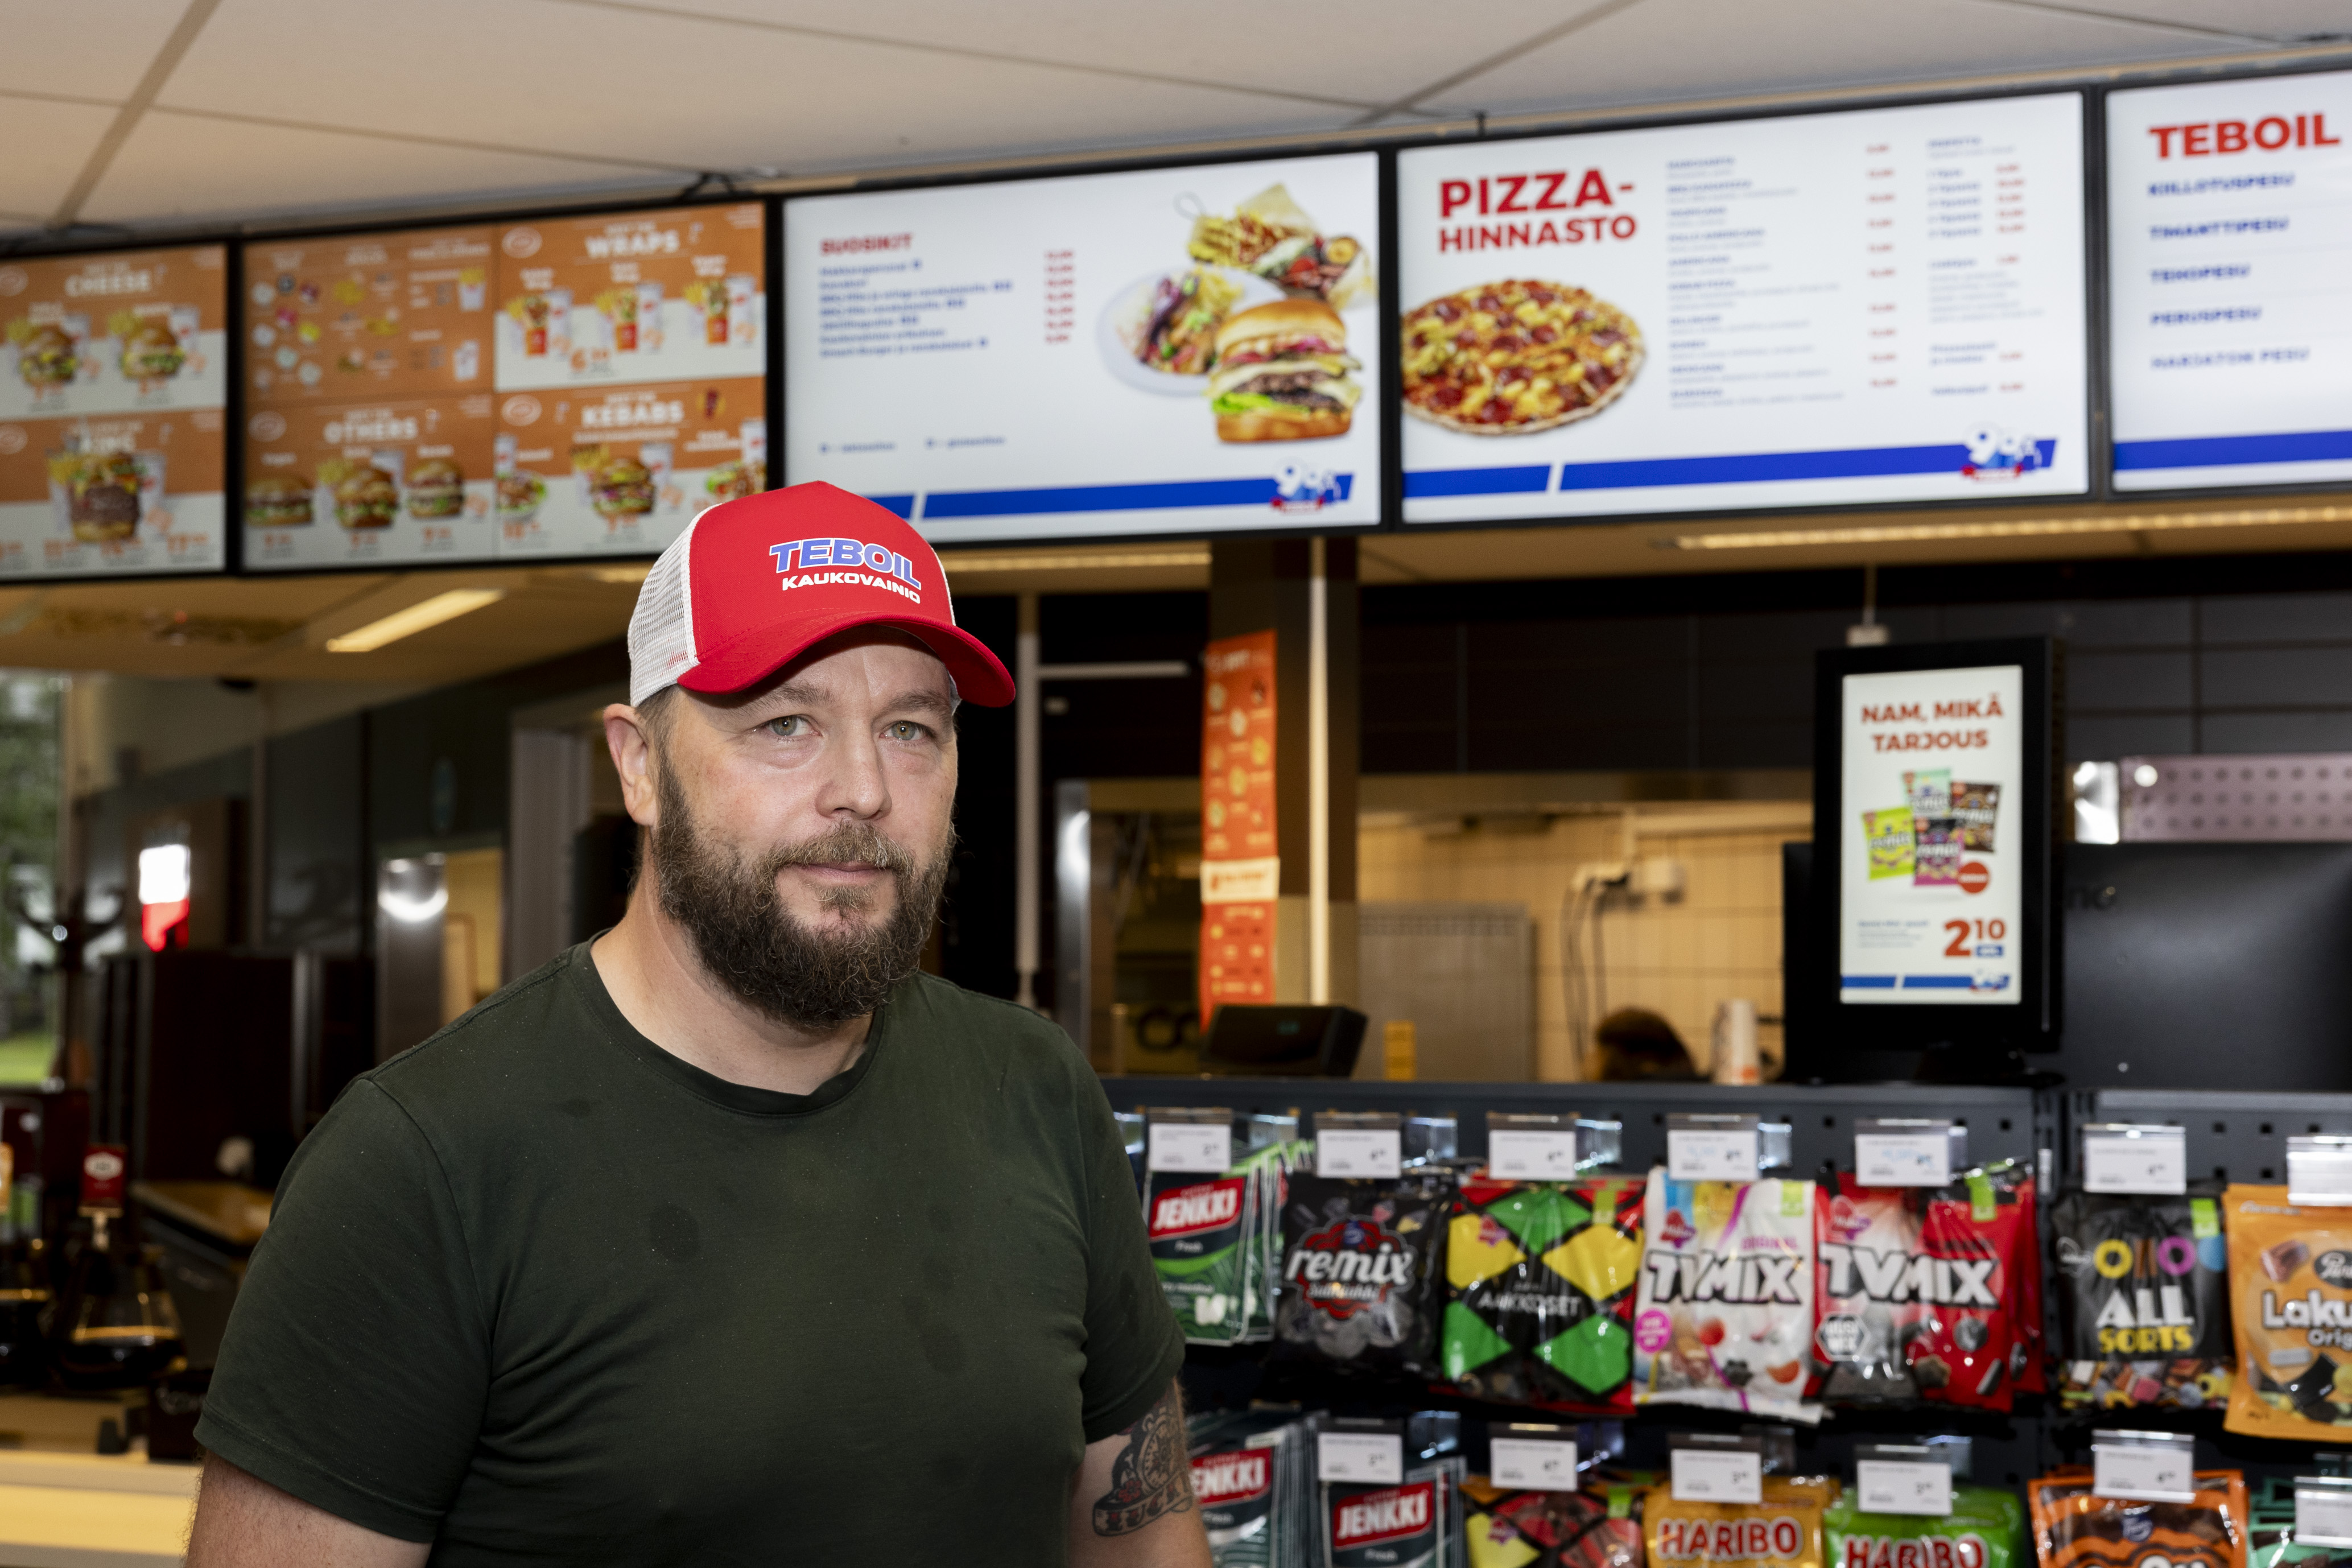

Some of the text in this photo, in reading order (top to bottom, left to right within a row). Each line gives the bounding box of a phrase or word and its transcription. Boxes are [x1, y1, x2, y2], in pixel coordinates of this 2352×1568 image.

[2149, 113, 2341, 159] TEBOIL
[1440, 168, 1635, 218] PIZZA-
[585, 230, 680, 257] WRAPS
[1440, 214, 1637, 252] HINNASTO
[324, 418, 418, 443] OTHERS
[583, 402, 683, 427] KEBABS
[769, 538, 922, 591] TEBOIL
[782, 572, 921, 604] KAUKOVAINIO
[1862, 694, 2003, 724] NAM, MIKÄ
[1872, 729, 1989, 753] TARJOUS
[1153, 1187, 1237, 1231] JENKKI
[1284, 1243, 1413, 1285] remix
[2095, 1285, 2195, 1328] ALL
[2097, 1327, 2194, 1354] SORTS
[1189, 1455, 1266, 1497] ENKKI
[1336, 1489, 1429, 1539] JENKKI
[1658, 1519, 1800, 1559] HARIBO
[1846, 1534, 1986, 1568] HARIBO
